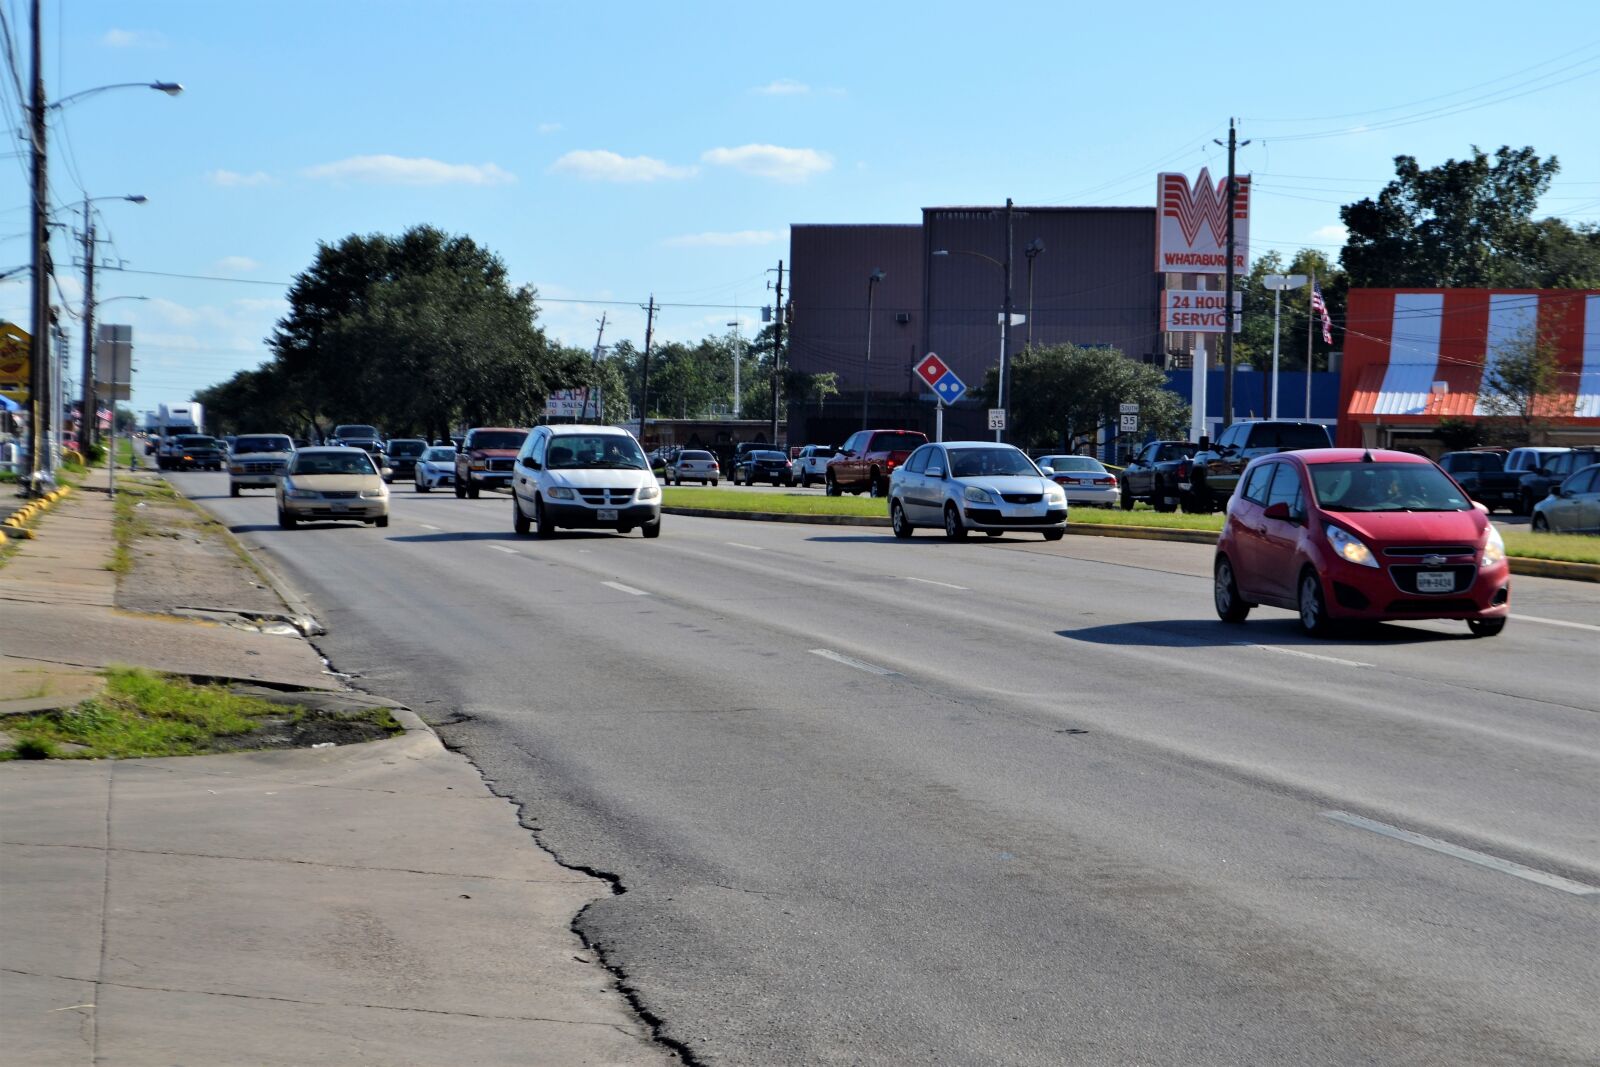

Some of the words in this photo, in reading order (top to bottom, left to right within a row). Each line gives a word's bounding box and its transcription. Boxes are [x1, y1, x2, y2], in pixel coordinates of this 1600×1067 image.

[1164, 252, 1244, 267] WHATABURER
[1172, 296, 1190, 309] 24
[1196, 296, 1228, 309] HOU
[1172, 312, 1231, 327] SERVIC
[1120, 404, 1138, 412] SOUTH
[991, 420, 1004, 428] 35
[1123, 416, 1135, 425] 35
